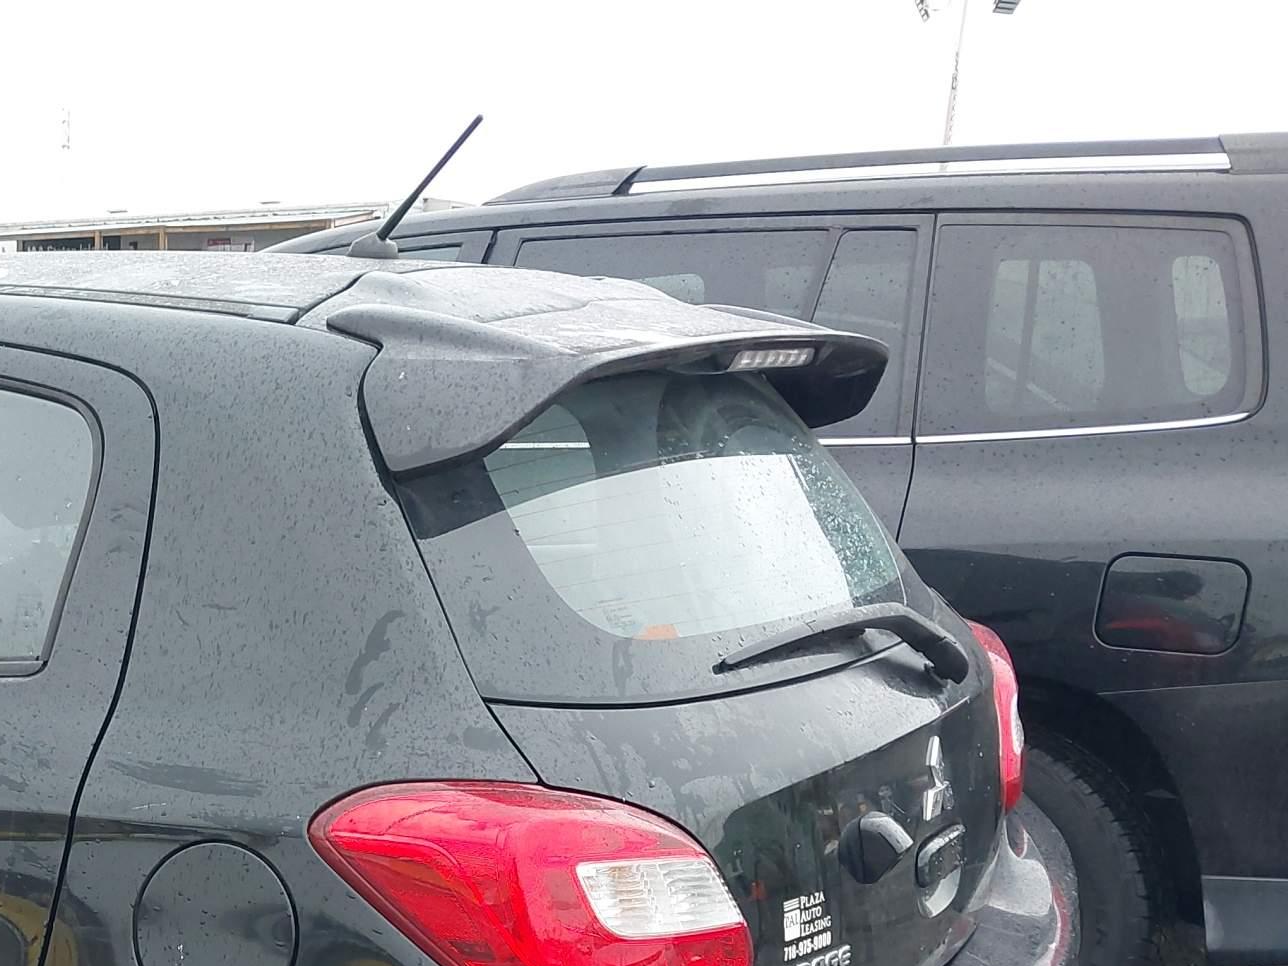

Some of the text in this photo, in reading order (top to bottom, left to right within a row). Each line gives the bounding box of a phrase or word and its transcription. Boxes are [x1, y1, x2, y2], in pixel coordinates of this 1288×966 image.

[800, 890, 826, 909] PLAZA
[800, 905, 823, 923] AUTO
[800, 915, 832, 937] LEASING
